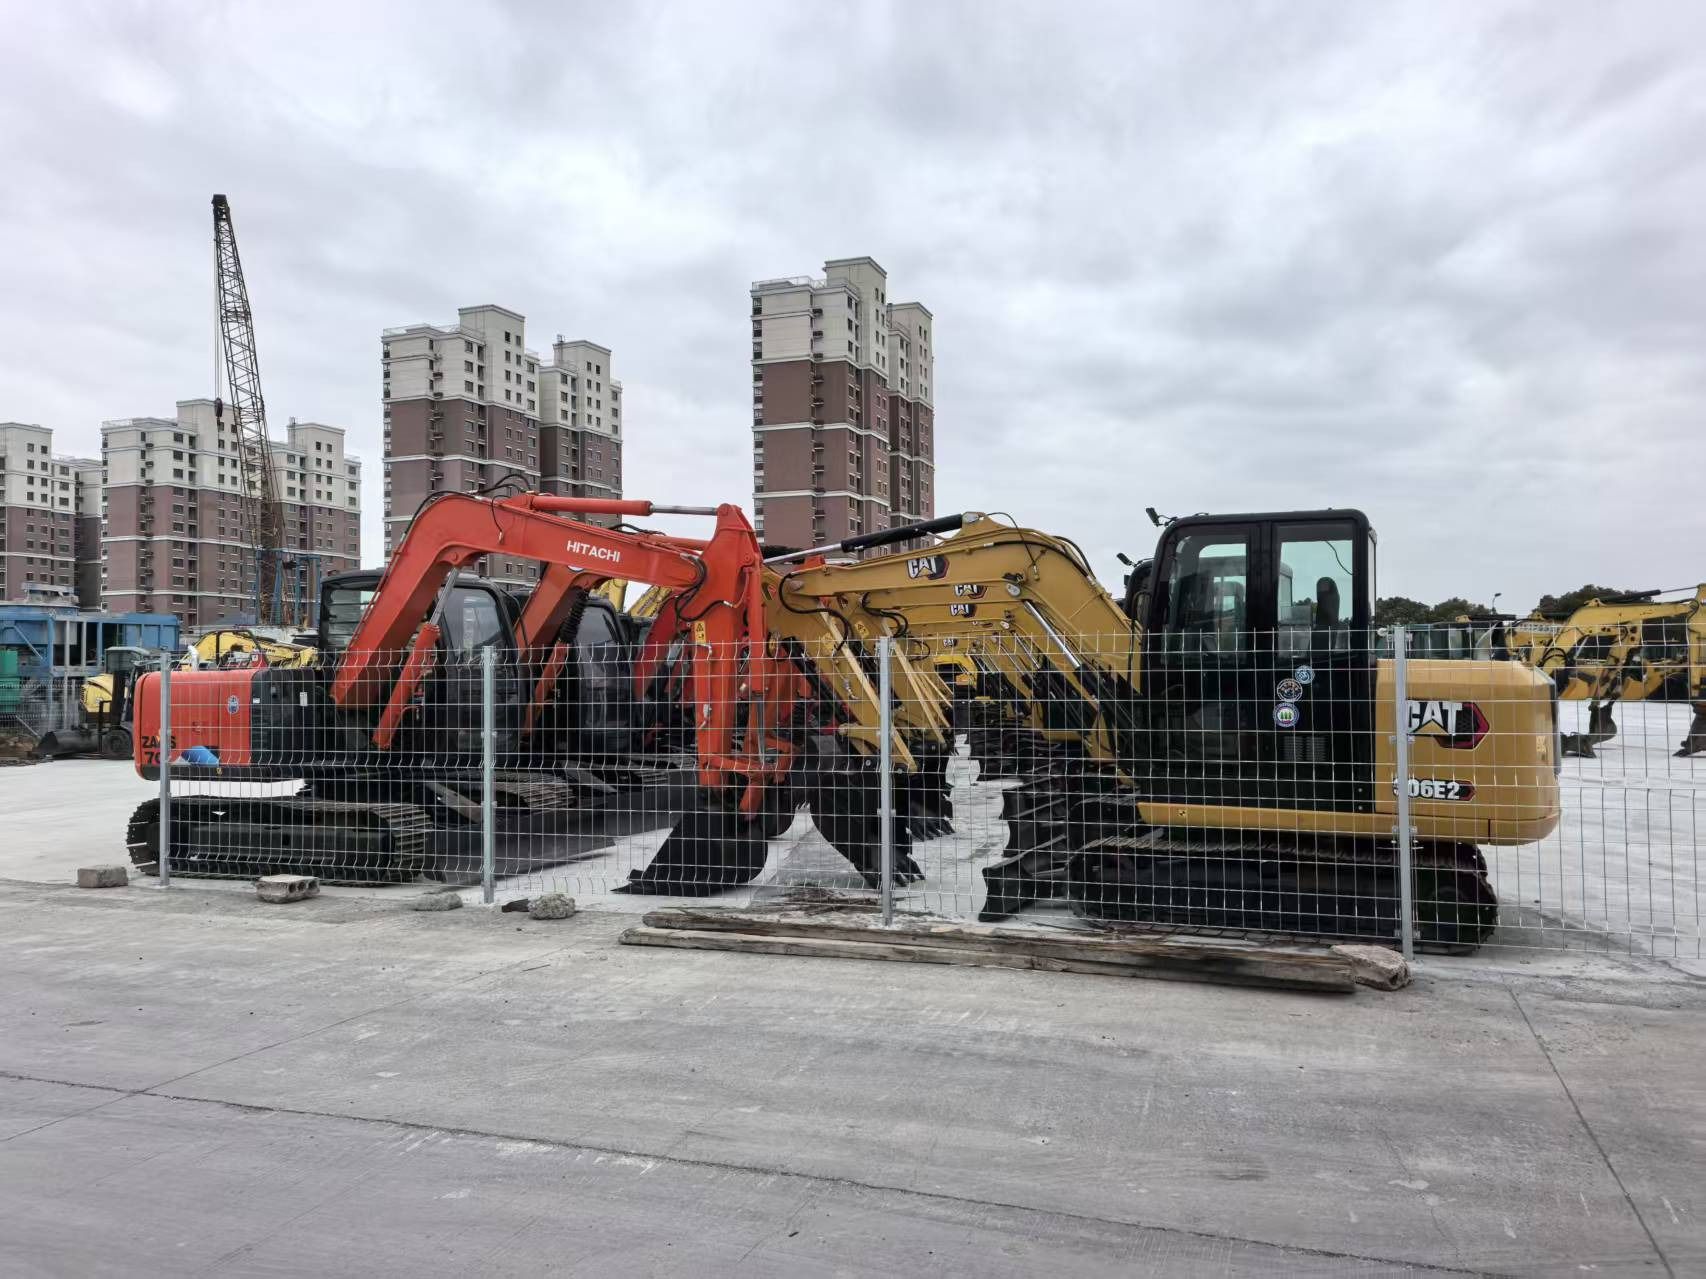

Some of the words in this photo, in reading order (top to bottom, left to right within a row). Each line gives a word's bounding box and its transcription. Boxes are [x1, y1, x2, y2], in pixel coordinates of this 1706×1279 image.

[567, 540, 621, 563] HITACHI
[907, 556, 937, 578] CAT
[954, 584, 977, 597] CAT
[950, 603, 970, 617] CAT
[1406, 700, 1463, 735] CAT
[141, 735, 176, 749] ZAS
